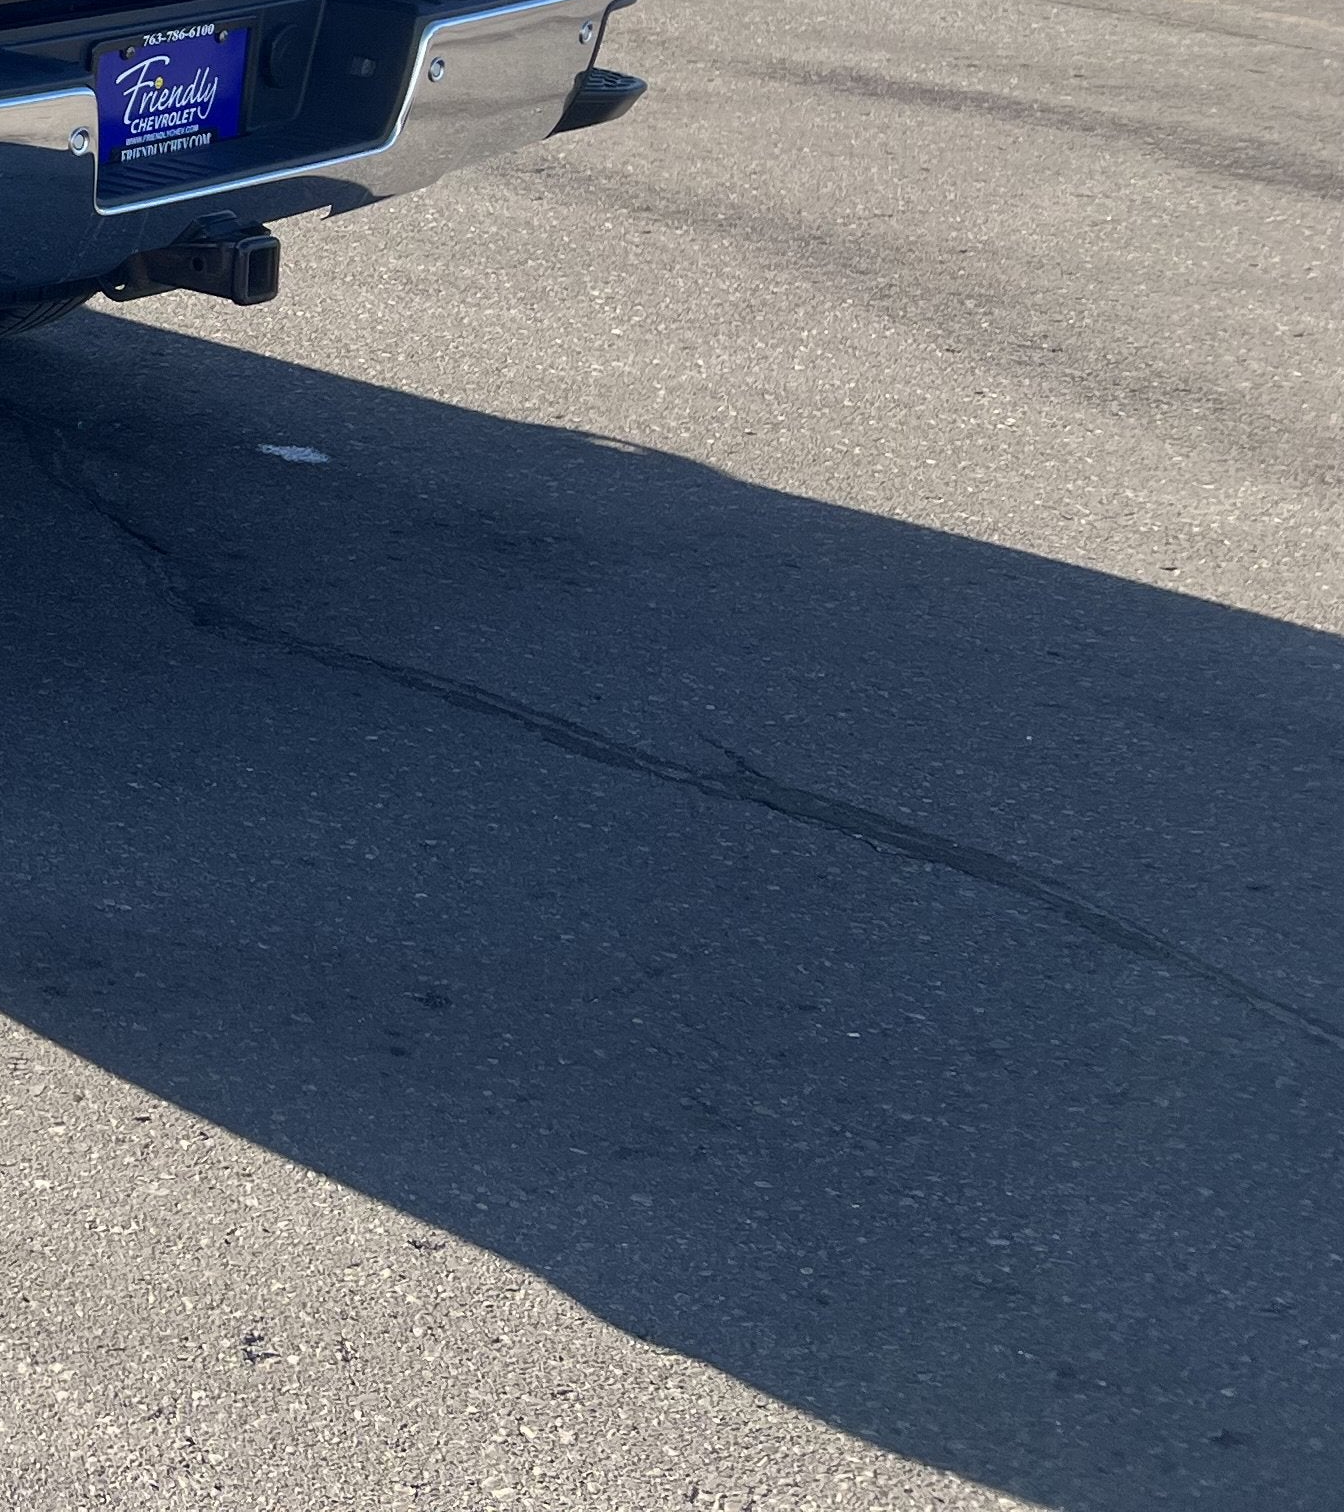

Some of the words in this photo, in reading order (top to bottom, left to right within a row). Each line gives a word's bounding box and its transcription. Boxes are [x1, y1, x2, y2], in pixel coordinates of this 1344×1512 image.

[142, 23, 215, 46] 763-786-6100
[115, 55, 219, 125] Friendly
[130, 107, 197, 134] CHEVROLET
